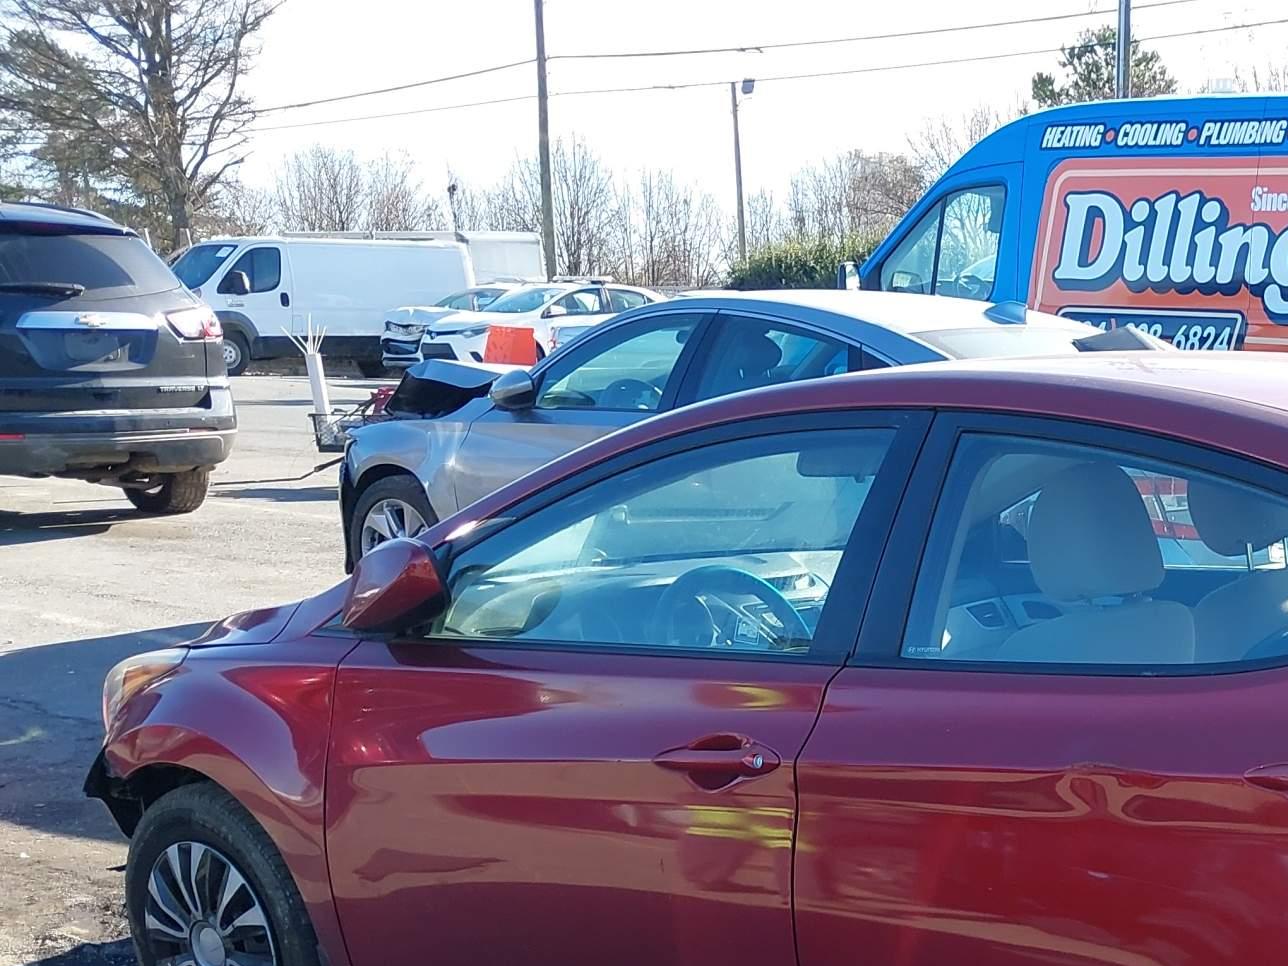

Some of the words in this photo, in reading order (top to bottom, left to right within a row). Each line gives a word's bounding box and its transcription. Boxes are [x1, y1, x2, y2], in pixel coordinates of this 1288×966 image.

[1042, 124, 1104, 148] HEATING
[1117, 122, 1187, 147] COOLING
[1199, 119, 1288, 145] PLUMBING
